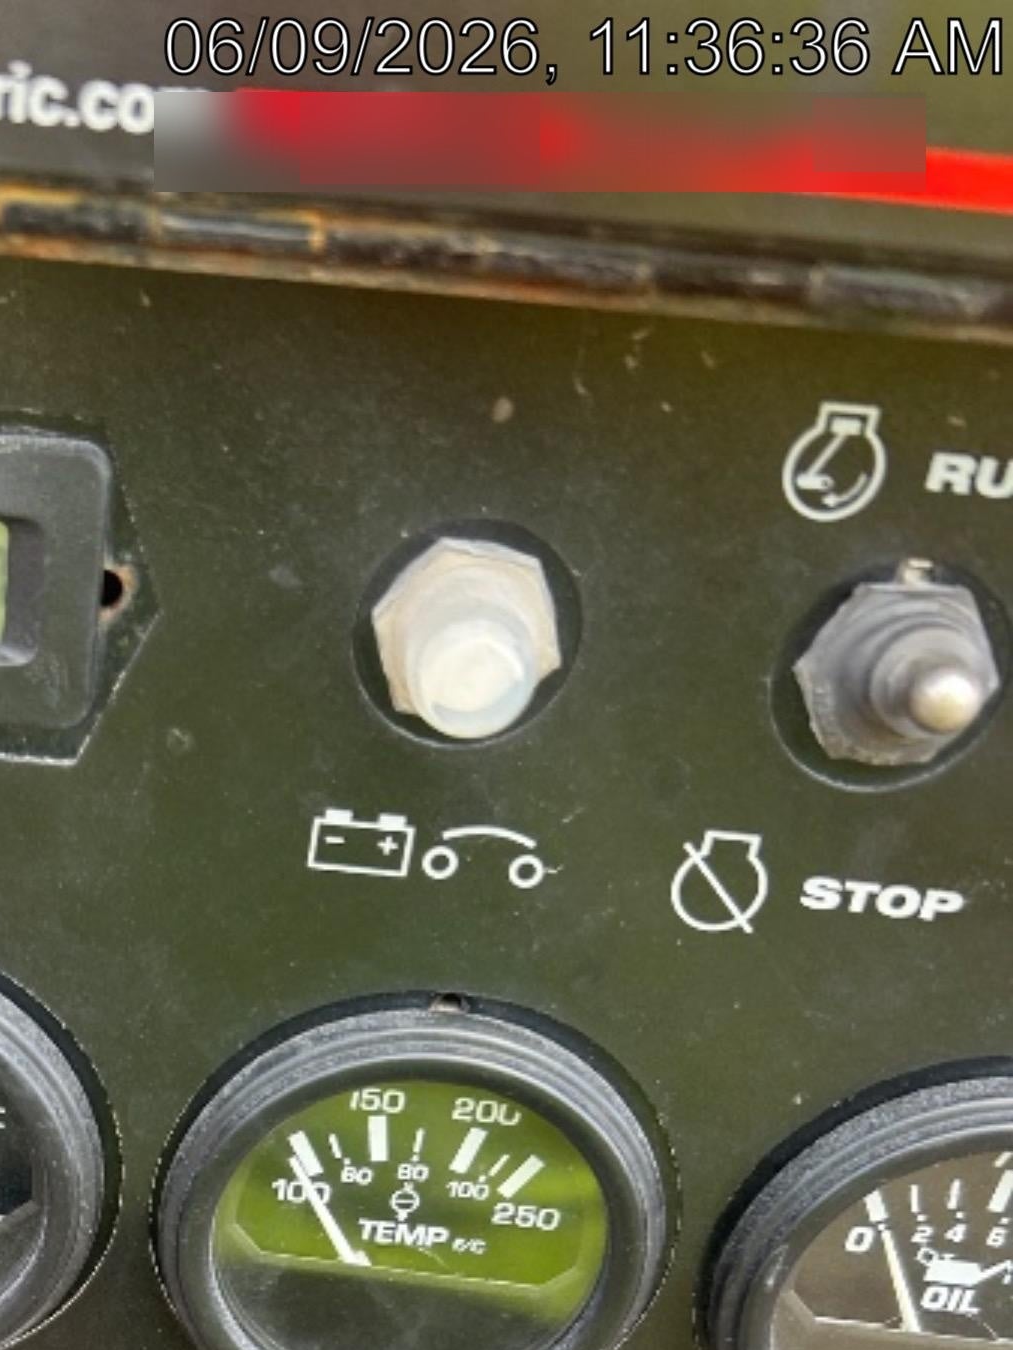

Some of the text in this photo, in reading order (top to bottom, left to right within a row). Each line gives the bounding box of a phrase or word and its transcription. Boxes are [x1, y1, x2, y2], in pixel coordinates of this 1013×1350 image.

[800, 876, 965, 922] STOP
[349, 1088, 405, 1114] 150
[446, 1181, 490, 1200] 100
[491, 1202, 562, 1231] 250
[358, 1217, 450, 1248] TEMP
[845, 1226, 875, 1253] 0
[910, 1224, 934, 1244] 2
[943, 1222, 967, 1243] 4
[920, 1285, 981, 1315] OIL
